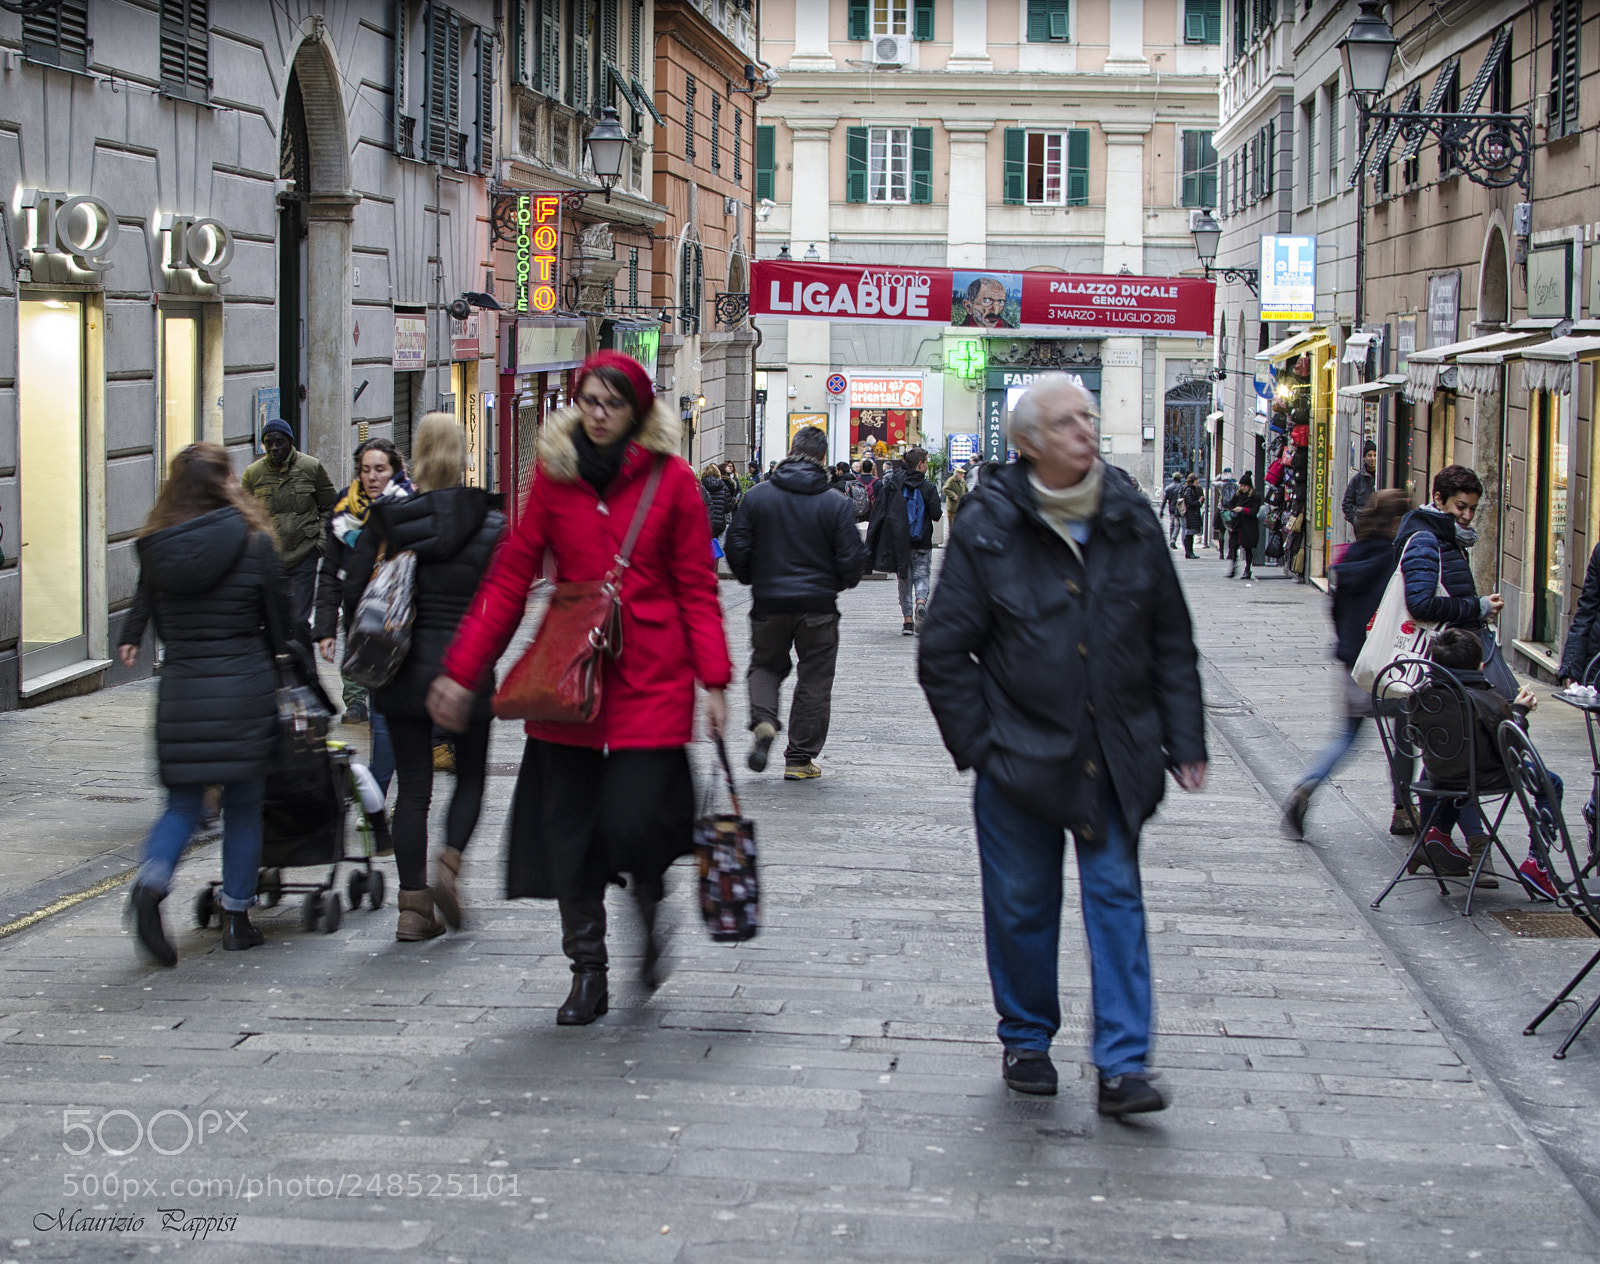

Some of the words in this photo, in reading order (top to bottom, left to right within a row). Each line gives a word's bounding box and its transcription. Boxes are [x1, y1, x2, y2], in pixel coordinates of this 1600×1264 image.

[517, 196, 530, 311] FOTOCOPIE
[533, 197, 559, 311] FOTO
[859, 269, 931, 288] Antonio
[770, 281, 930, 317] LIGABUE
[1050, 281, 1117, 296] PALAZZO
[1121, 284, 1178, 298] DUCALE
[1092, 295, 1138, 307] GENOVA
[1048, 308, 1055, 319] 3
[1057, 310, 1096, 321] MARZO
[1106, 311, 1110, 322] 1
[1112, 312, 1152, 323] LUGLIO
[1153, 313, 1176, 325] 2018
[851, 381, 887, 392] Ravioli
[851, 391, 900, 403] Orientali
[990, 401, 999, 461] FARMACIA
[1316, 461, 1324, 527] FOTOCOPIE
